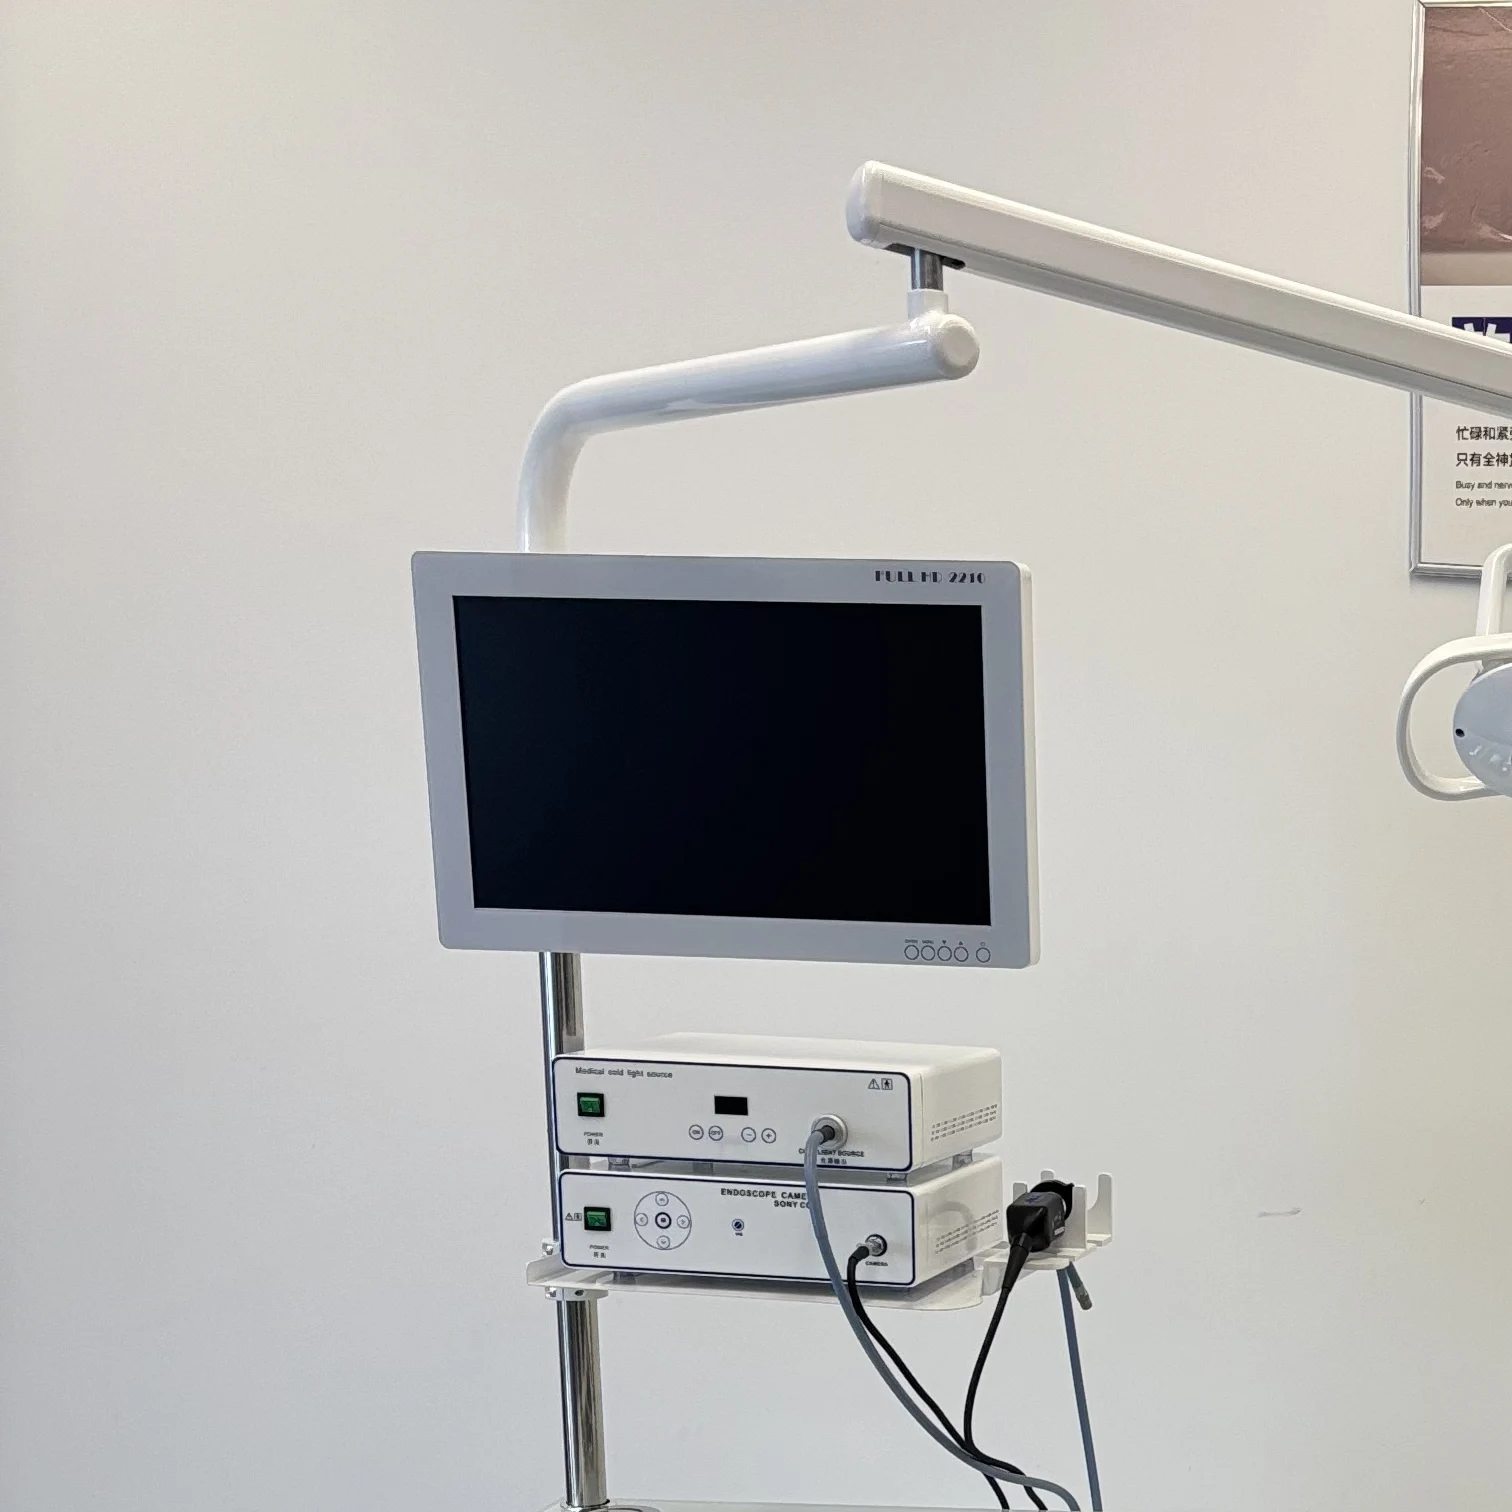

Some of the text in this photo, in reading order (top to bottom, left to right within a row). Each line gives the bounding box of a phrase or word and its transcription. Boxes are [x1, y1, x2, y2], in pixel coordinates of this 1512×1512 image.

[1477, 481, 1492, 489] and
[1455, 498, 1473, 508] Only
[1475, 498, 1497, 507] when
[1498, 499, 1512, 508] you
[875, 570, 916, 583] FULL
[921, 571, 943, 583] HD
[720, 1188, 807, 1200] ENDOSCOPE CAME
[774, 1200, 798, 1208] SONY
